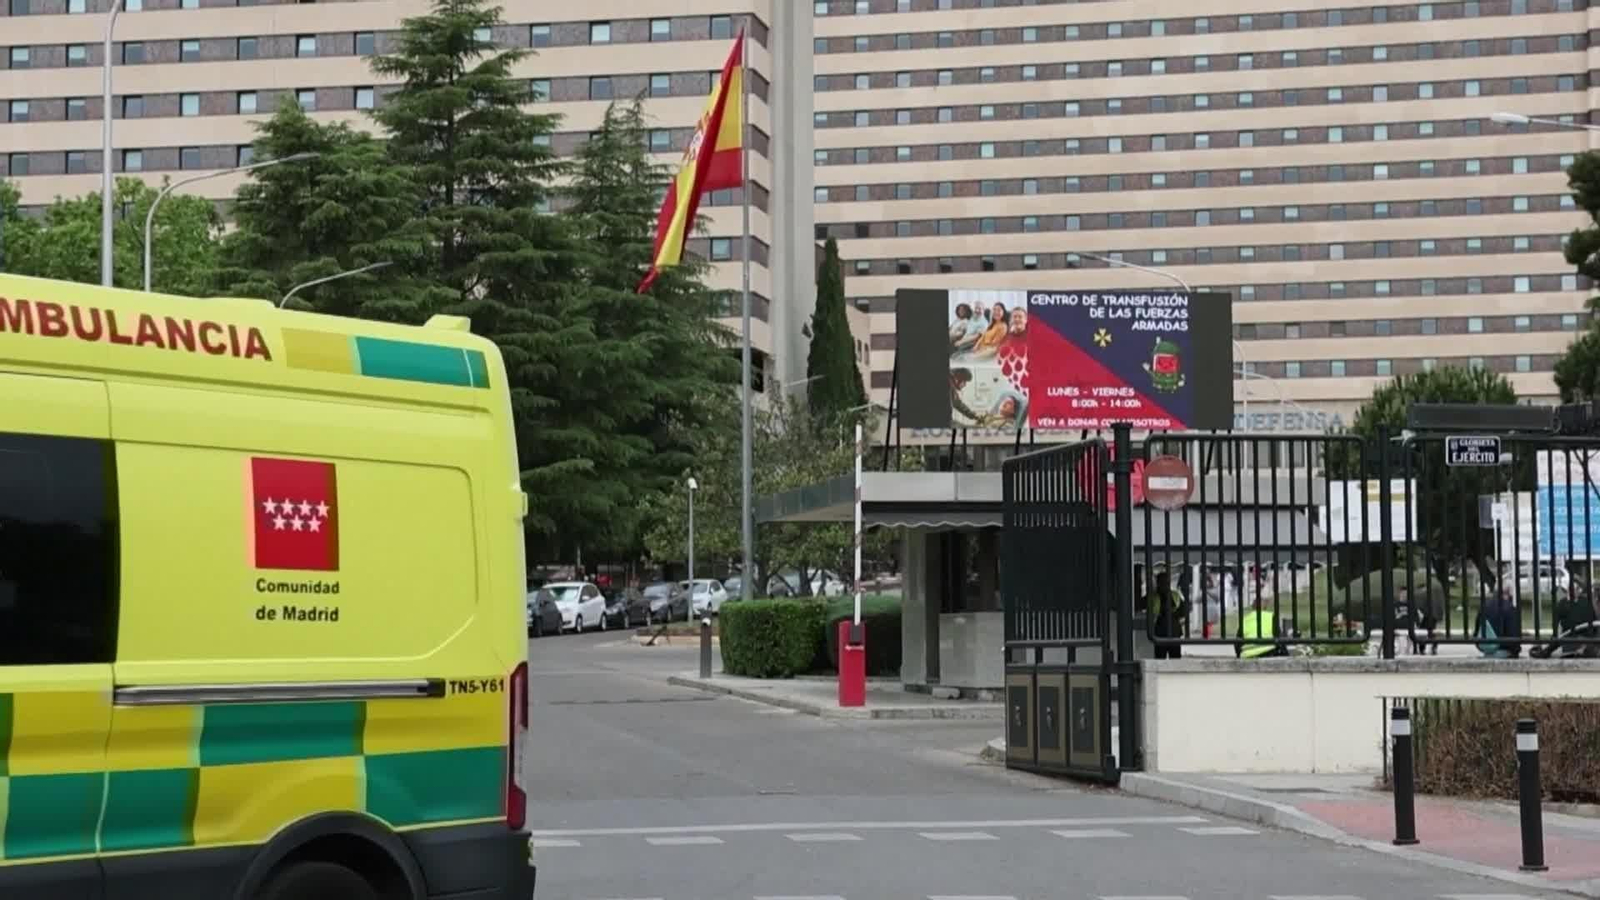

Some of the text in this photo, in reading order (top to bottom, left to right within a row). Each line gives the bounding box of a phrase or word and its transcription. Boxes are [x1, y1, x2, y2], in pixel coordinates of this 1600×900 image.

[1031, 293, 1188, 306] CENTRO DE TRANSFUSIÓN
[1090, 308, 1188, 319] DE LAS FUERZAS
[1132, 320, 1188, 331] ARMADAS
[1047, 387, 1079, 396] LUNES
[1092, 387, 1135, 396] VIERNES
[1110, 399, 1141, 408] 14:00h
[1038, 418, 1056, 427] VEN
[1059, 419, 1066, 427] A
[1068, 418, 1098, 427] DONAR
[256, 577, 340, 594] Comunidad
[255, 605, 339, 622] de Madrid
[449, 678, 504, 694] TN5-Y61
